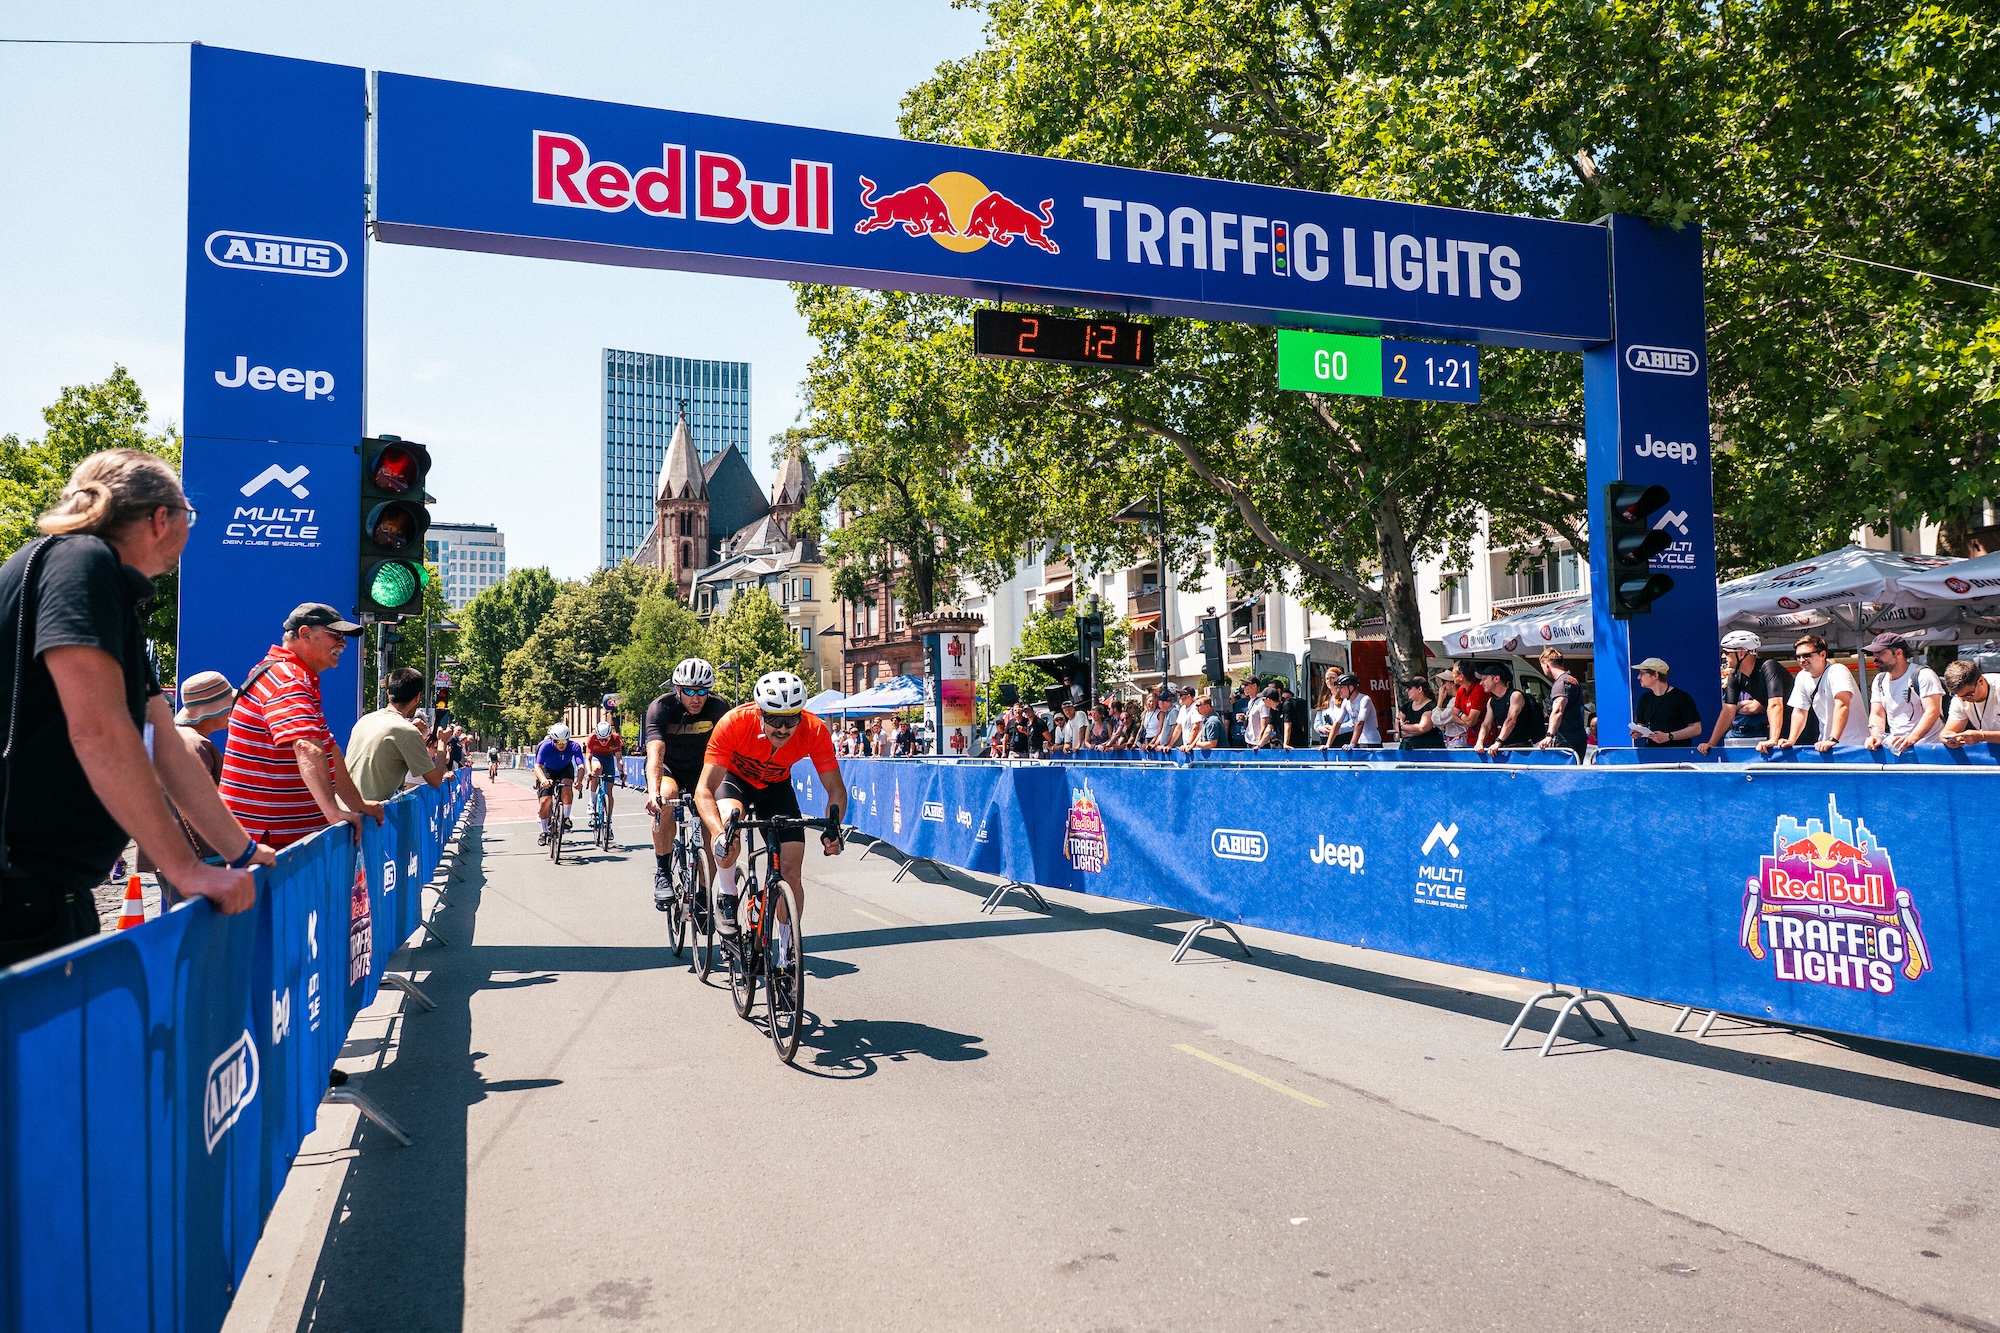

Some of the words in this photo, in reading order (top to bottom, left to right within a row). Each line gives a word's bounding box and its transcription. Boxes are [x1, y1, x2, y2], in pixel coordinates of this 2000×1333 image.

[533, 130, 686, 219] Red
[695, 150, 833, 235] Bull
[223, 238, 330, 270] ABUS
[1083, 196, 1330, 283] TRAFFIC
[1343, 227, 1522, 301] LIGHTS
[1018, 317, 1039, 353] 2
[1085, 325, 1142, 361] 1:21
[1314, 349, 1348, 381] GO
[1393, 354, 1408, 384] 2
[1425, 357, 1471, 389] 1:21
[1635, 350, 1690, 371] ABUS
[214, 355, 335, 401] Jeep
[1635, 433, 1697, 465] Jeep
[233, 506, 315, 522] MULTI
[225, 523, 319, 539] CYCLE
[1664, 541, 1693, 552] ULTI
[1648, 553, 1695, 563] YCLE
[1552, 624, 1585, 638] BINDING
[1071, 814, 1086, 831] Red
[1218, 834, 1261, 856] ABUS
[1310, 834, 1365, 875] Jeep
[1072, 854, 1101, 874] LIGHTS
[1419, 865, 1463, 883] MULTI
[1415, 882, 1467, 901] CYCLE
[1769, 869, 1824, 902] Red
[1826, 872, 1886, 907] Bull
[1761, 914, 1903, 963] TRAFFIC
[1775, 948, 1894, 993] LIGHTS
